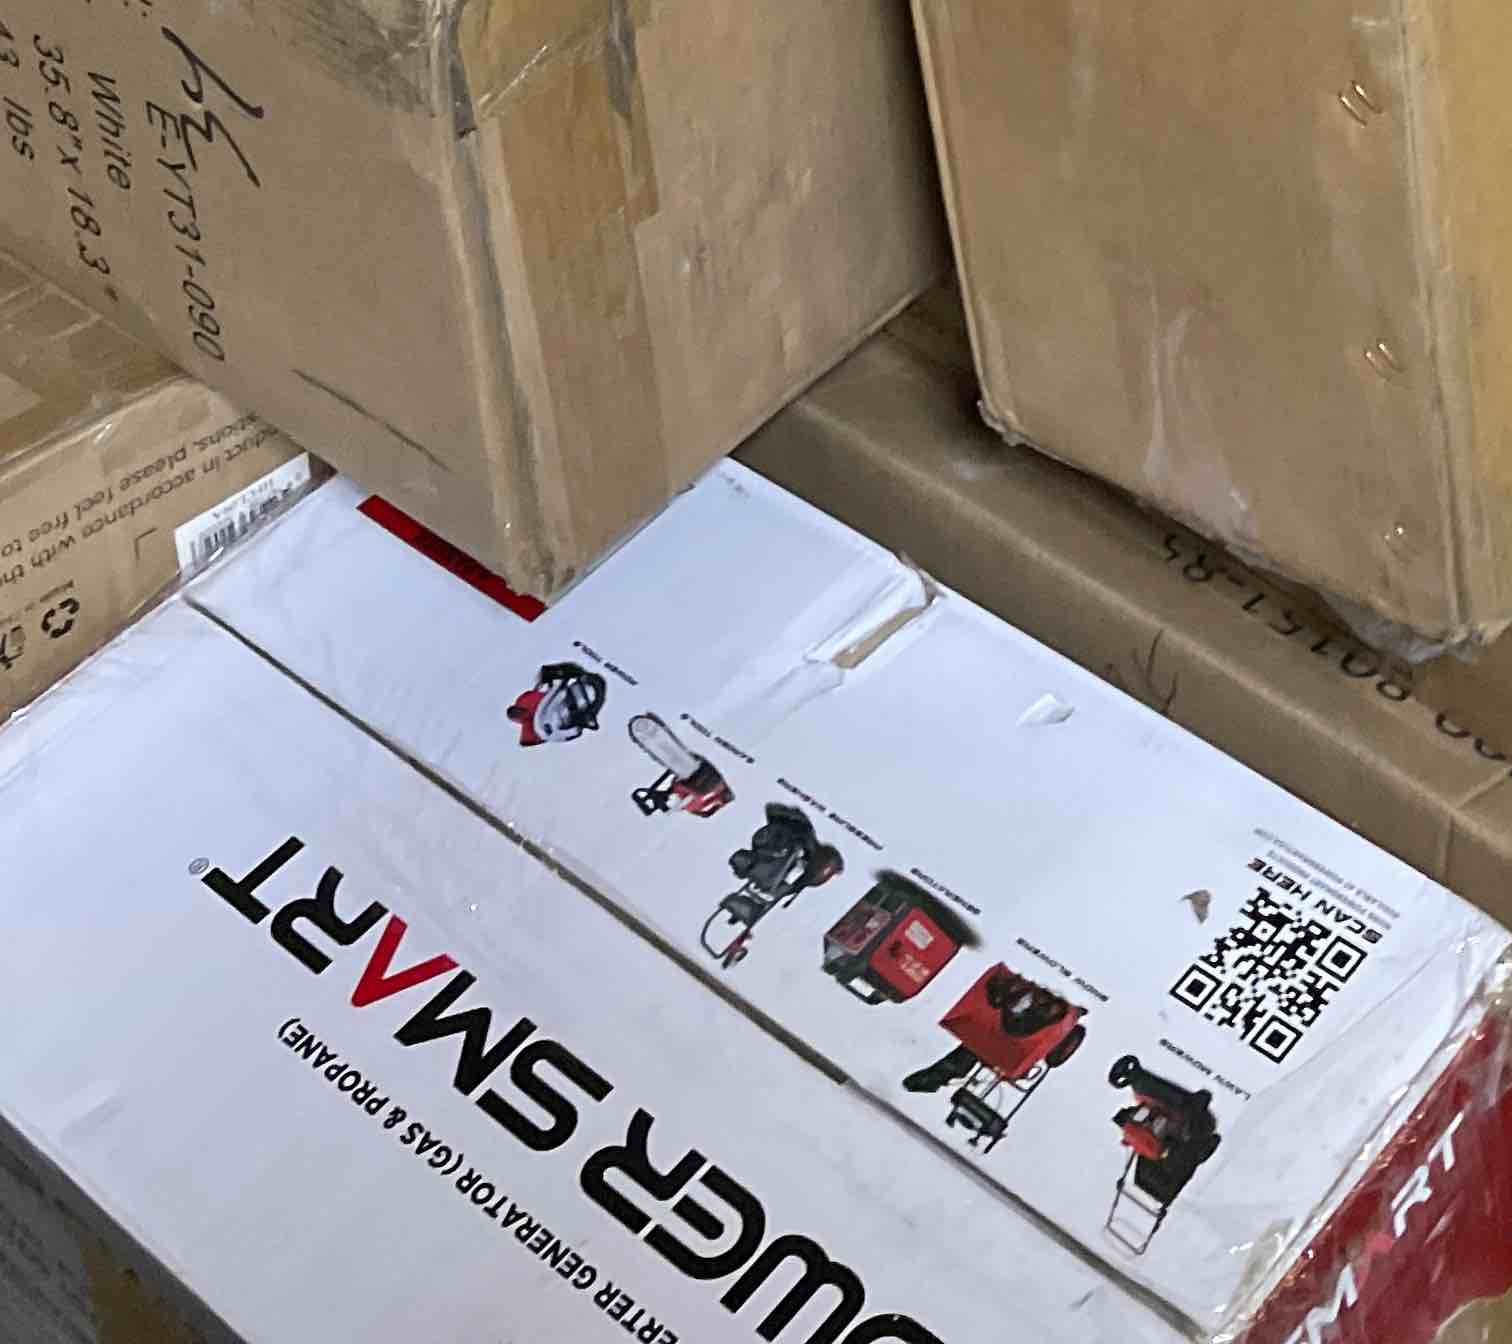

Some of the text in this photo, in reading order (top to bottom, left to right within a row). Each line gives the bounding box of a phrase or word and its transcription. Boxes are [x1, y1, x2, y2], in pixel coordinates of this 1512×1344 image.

[3, 95, 35, 162] lbs
[87, 70, 133, 192] White
[145, 99, 226, 363] E-YT31-090
[117, 446, 187, 491] please
[26, 511, 71, 545] free
[72, 487, 115, 520] feel
[80, 468, 197, 539] accordance
[28, 534, 76, 570] with
[1244, 854, 1382, 945] SCAN HERE
[200, 835, 948, 1344] WER SMART
[278, 1016, 386, 1120] PROPANE)
[1158, 1036, 1251, 1101] LAWN MOWERS
[401, 1120, 463, 1182] (GAS
[457, 1164, 600, 1293] GENERATOR
